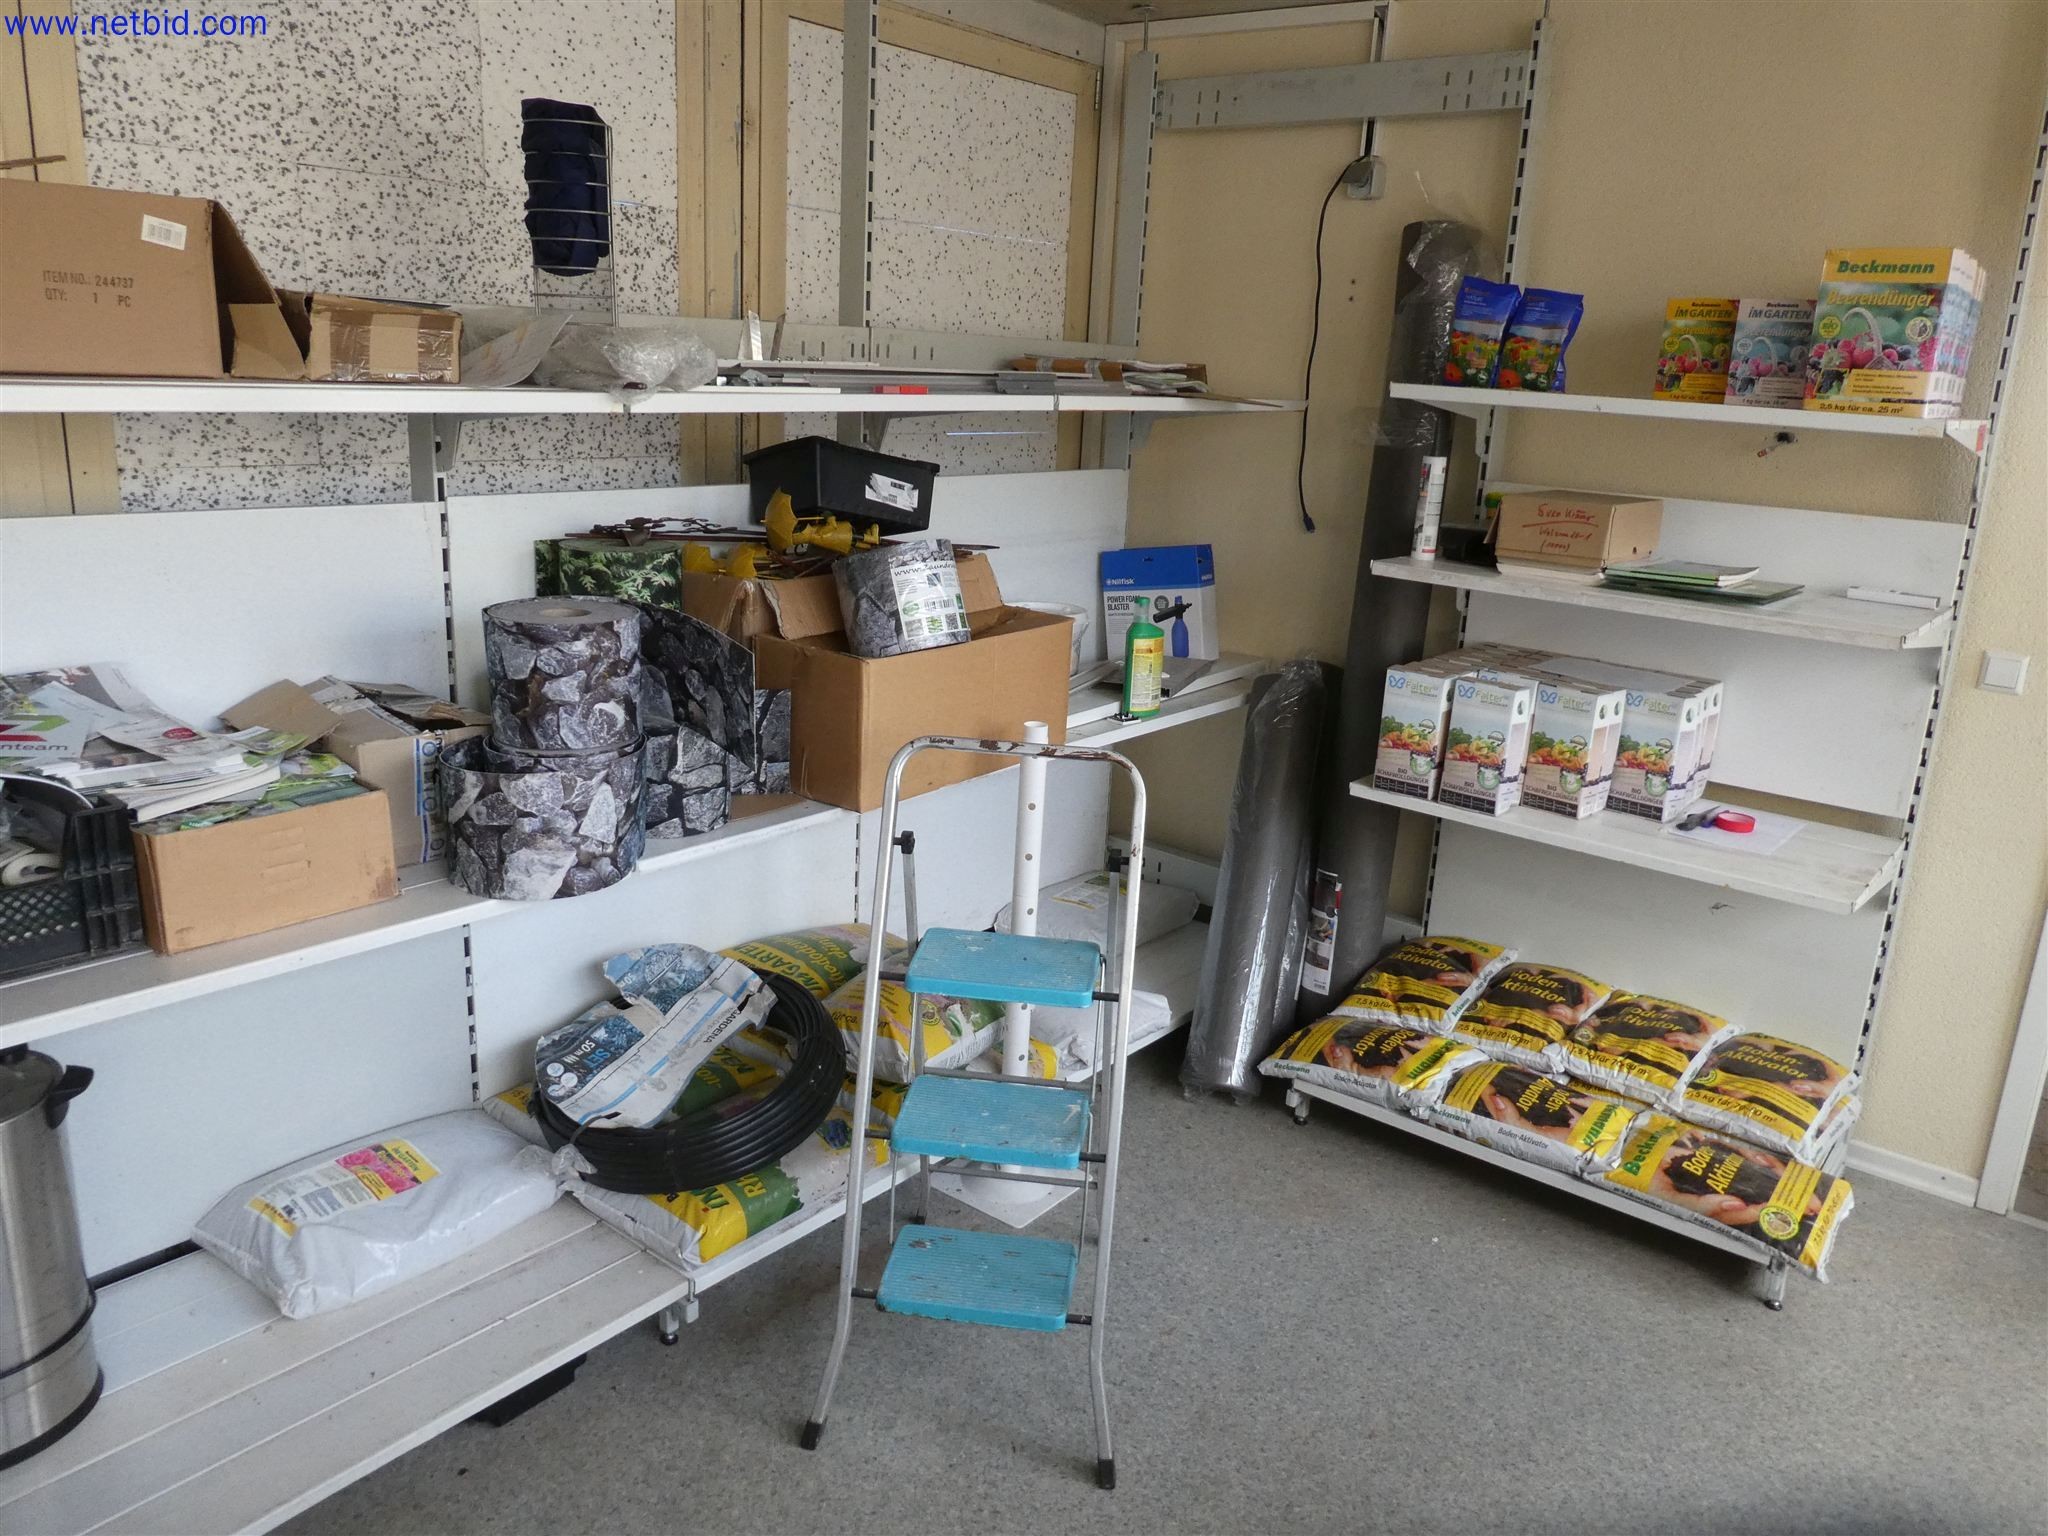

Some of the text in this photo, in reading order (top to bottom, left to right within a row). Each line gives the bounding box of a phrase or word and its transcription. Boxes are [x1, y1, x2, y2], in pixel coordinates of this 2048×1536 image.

[1837, 260, 1936, 274] Beckmann
[42, 270, 68, 284] ITEM
[95, 275, 134, 289] 244737
[45, 287, 68, 301] QTY:
[117, 294, 132, 308] PC
[1827, 287, 1936, 311] Beerendünger
[1689, 309, 1733, 319] GARTEN
[1763, 309, 1812, 320] GARTEN
[1834, 404, 1846, 413] kg
[1877, 406, 1889, 414] 25
[1107, 595, 1126, 603] POWER
[1107, 603, 1130, 611] BLASTER
[1405, 679, 1433, 693] Falter
[1475, 689, 1504, 703] Falter
[1557, 695, 1586, 708] Falter
[1643, 698, 1672, 712] Falter
[1502, 978, 1567, 1003] ktivator
[1368, 1000, 1379, 1009] kg
[703, 1010, 743, 1043] GARDENA
[1471, 1026, 1482, 1036] kg
[580, 1039, 596, 1053] 50
[585, 1048, 611, 1070] SET
[1738, 1045, 1803, 1065] Boden-
[1274, 1061, 1311, 1075] Beckmann
[1720, 1050, 1809, 1079] Aktivator
[1702, 1093, 1715, 1104] kg
[1429, 1105, 1472, 1125] Beckmann
[1497, 1127, 1550, 1150] Boden-Aktivator
